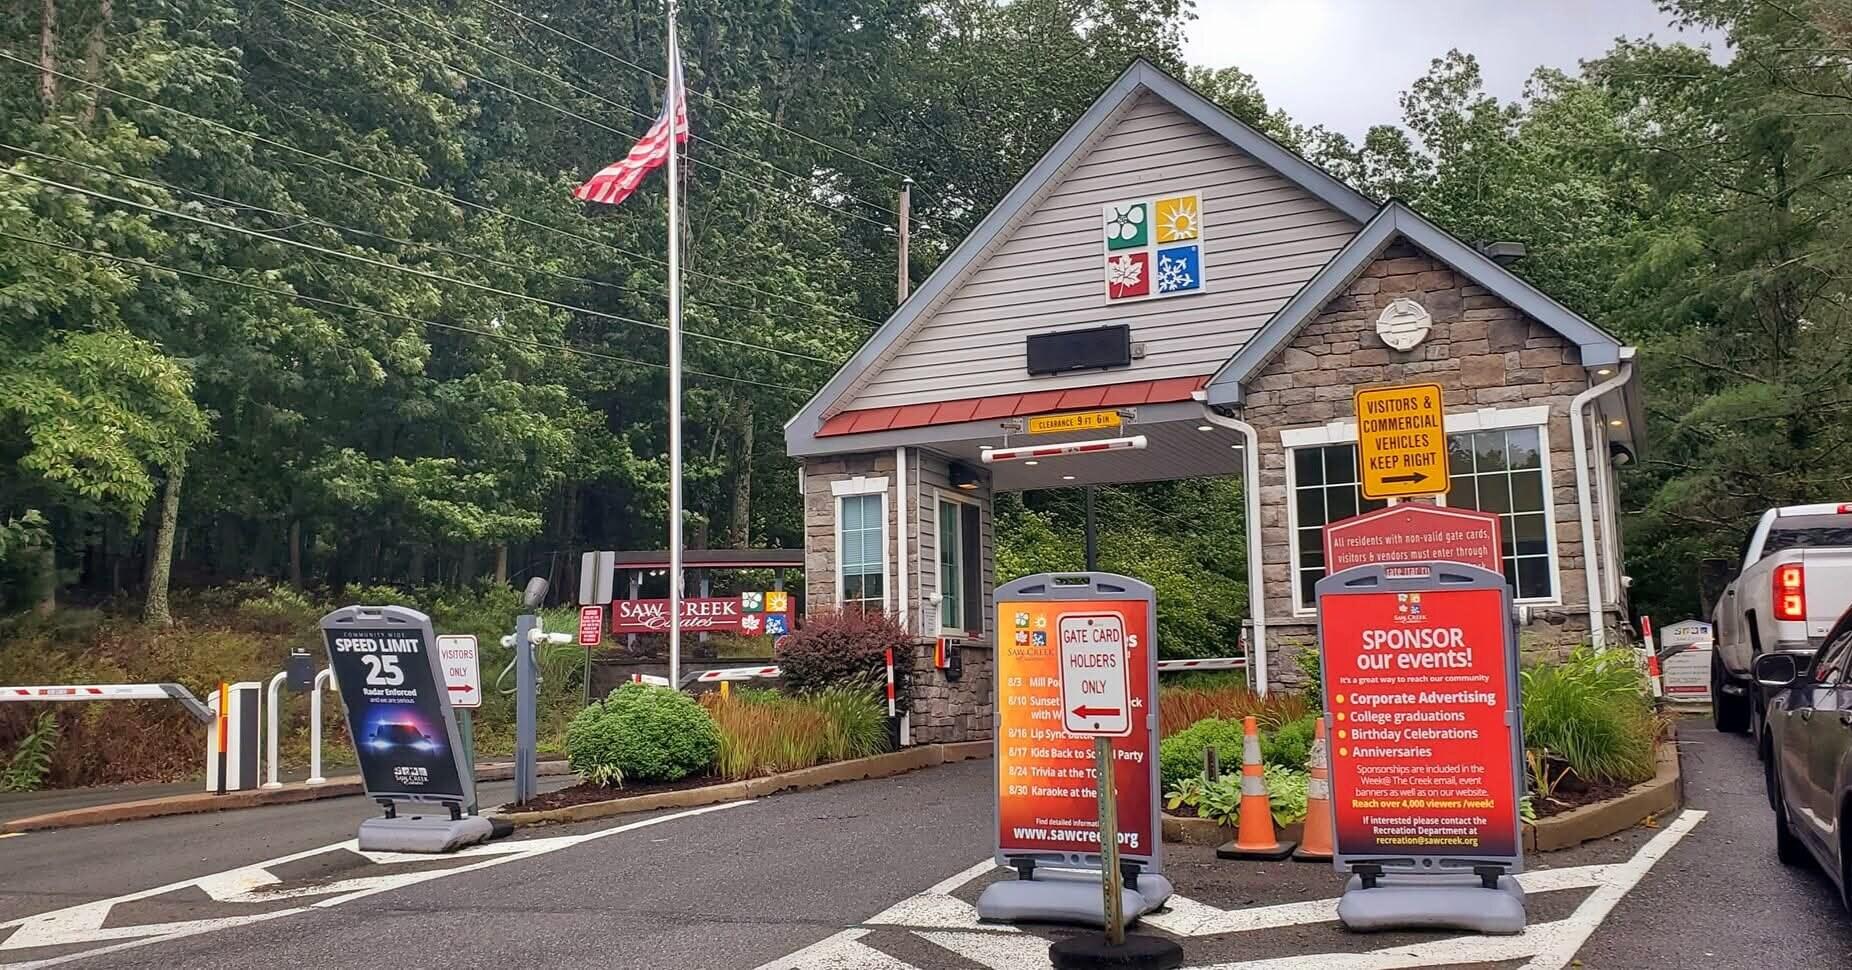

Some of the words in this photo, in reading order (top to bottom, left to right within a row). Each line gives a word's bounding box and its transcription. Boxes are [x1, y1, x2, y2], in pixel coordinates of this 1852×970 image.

[1367, 397, 1418, 414] VISITORS
[1423, 396, 1432, 409] &
[1039, 419, 1074, 429] CLEARANCE
[1077, 416, 1083, 425] 9
[1085, 417, 1091, 425] FT
[1096, 414, 1102, 424] 6
[1103, 416, 1110, 424] IN
[1363, 415, 1439, 433] COMMERCIAL
[1375, 434, 1430, 451] VEHICLES
[1370, 455, 1400, 470] KEEP
[1404, 452, 1437, 467] RIGHT
[1334, 537, 1345, 548] All
[1347, 535, 1384, 547] residents
[1384, 533, 1403, 545] with
[1405, 530, 1443, 544] non-valid
[1446, 530, 1464, 544] gate
[1466, 528, 1490, 541] cards,
[1338, 552, 1367, 563] visitors
[1377, 550, 1409, 562] vendors
[1411, 549, 1431, 560] must
[1432, 548, 1454, 559] enter
[1456, 545, 1489, 558] through
[620, 601, 666, 618] SAW
[1064, 629, 1089, 643] GATE
[1093, 628, 1120, 643] CARD
[1362, 628, 1465, 650] SPONSOR
[335, 638, 378, 652] SPEED
[379, 639, 418, 653] LIMIT
[442, 649, 474, 659] VISITORS
[1070, 653, 1117, 668] HOLDERS
[1357, 653, 1393, 670] our
[1398, 648, 1473, 669] events!
[361, 654, 405, 686] 25
[450, 667, 467, 677] ONLY
[1030, 677, 1047, 688] Mill
[1340, 676, 1352, 684] It's
[1359, 675, 1379, 686] great
[1380, 676, 1396, 686] way
[1397, 675, 1406, 683] to
[1407, 674, 1429, 683] reach
[1429, 675, 1443, 683] our
[1444, 673, 1490, 684] community
[363, 688, 385, 696] Radar
[385, 688, 418, 697] Enforced
[1081, 680, 1107, 694] ONLY
[1008, 696, 1028, 706] 8/10
[1030, 696, 1060, 706] Sunset
[1350, 692, 1416, 708] Corporate
[1418, 690, 1497, 706] Advertising
[1031, 709, 1052, 720] with
[1350, 711, 1392, 725] College
[1393, 710, 1466, 725] graduations
[1008, 728, 1028, 739] 8/16
[1030, 728, 1044, 740] Lip
[1351, 728, 1401, 743] Birthday
[1403, 727, 1480, 740] Celebrations
[1008, 747, 1028, 757] 8/17
[1031, 748, 1050, 758] Kids
[1051, 748, 1073, 759] Back
[1074, 750, 1085, 759] to
[1118, 749, 1143, 763] Party
[1353, 746, 1433, 758] Anniversaries
[1008, 766, 1028, 776] 8/24
[1032, 766, 1057, 777] Trivia
[1057, 767, 1068, 778] at
[1068, 767, 1085, 778] the
[1356, 765, 1410, 776] Sponsorships
[1411, 766, 1425, 774] are
[1426, 764, 1460, 774] included
[1460, 764, 1468, 774] in
[1470, 764, 1485, 774] the
[1360, 776, 1392, 786] Week@
[1393, 776, 1408, 785] The
[1409, 776, 1433, 785] Creek
[1459, 776, 1482, 785] event
[1008, 784, 1028, 796] 8/30
[1031, 786, 1069, 797] Karaoke
[1070, 788, 1081, 798] at
[1081, 787, 1098, 799] the
[1355, 787, 1389, 797] banners
[1389, 789, 1400, 797] as
[1400, 787, 1417, 797] well
[1417, 789, 1426, 797] as
[1427, 789, 1439, 797] on
[1439, 789, 1454, 797] our
[1352, 799, 1380, 809] Reach
[1380, 800, 1400, 809] over
[1401, 799, 1426, 810] 4,000
[1426, 798, 1463, 809] viewers
[1463, 798, 1495, 809] /week!
[1036, 817, 1049, 826] Find
[1049, 818, 1073, 827] detailed
[1362, 815, 1370, 825] If
[1370, 815, 1413, 826] interested
[1414, 816, 1440, 827] please
[1440, 816, 1472, 826] contact
[1472, 815, 1488, 826] the
[1373, 825, 1417, 836] Recreation
[1417, 826, 1468, 837] Department
[1468, 827, 1479, 836] at
[1376, 836, 1480, 848] recreation@sawcreek.org
